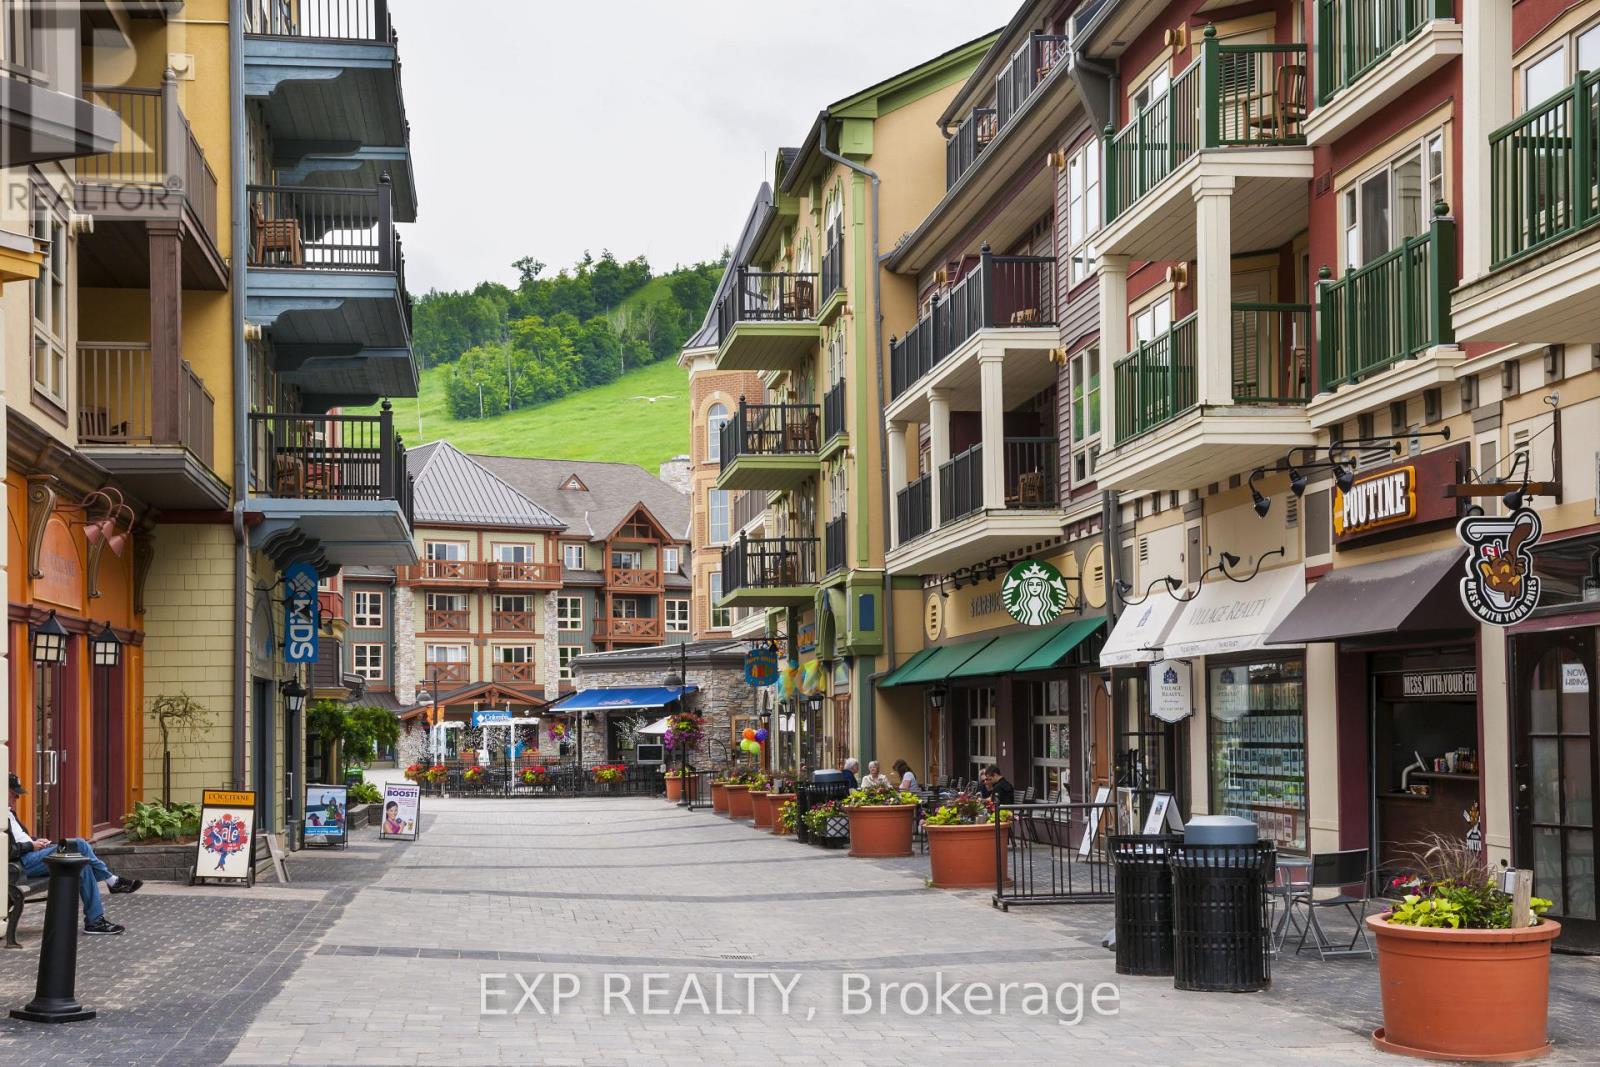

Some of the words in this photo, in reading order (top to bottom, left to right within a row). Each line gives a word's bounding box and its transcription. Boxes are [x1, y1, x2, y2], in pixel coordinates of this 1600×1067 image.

[1343, 472, 1406, 528] POUTINE
[1226, 598, 1267, 621] REALTY
[1467, 581, 1481, 607] MESS
[1478, 605, 1502, 622] WITH
[1504, 605, 1528, 622] YOUR
[1524, 579, 1537, 606] FRIES
[1404, 675, 1422, 694] MESS
[1423, 674, 1442, 693] WITH
[1443, 673, 1463, 692] YOUR
[1464, 673, 1477, 691] FRI
[213, 825, 238, 845] Sale
